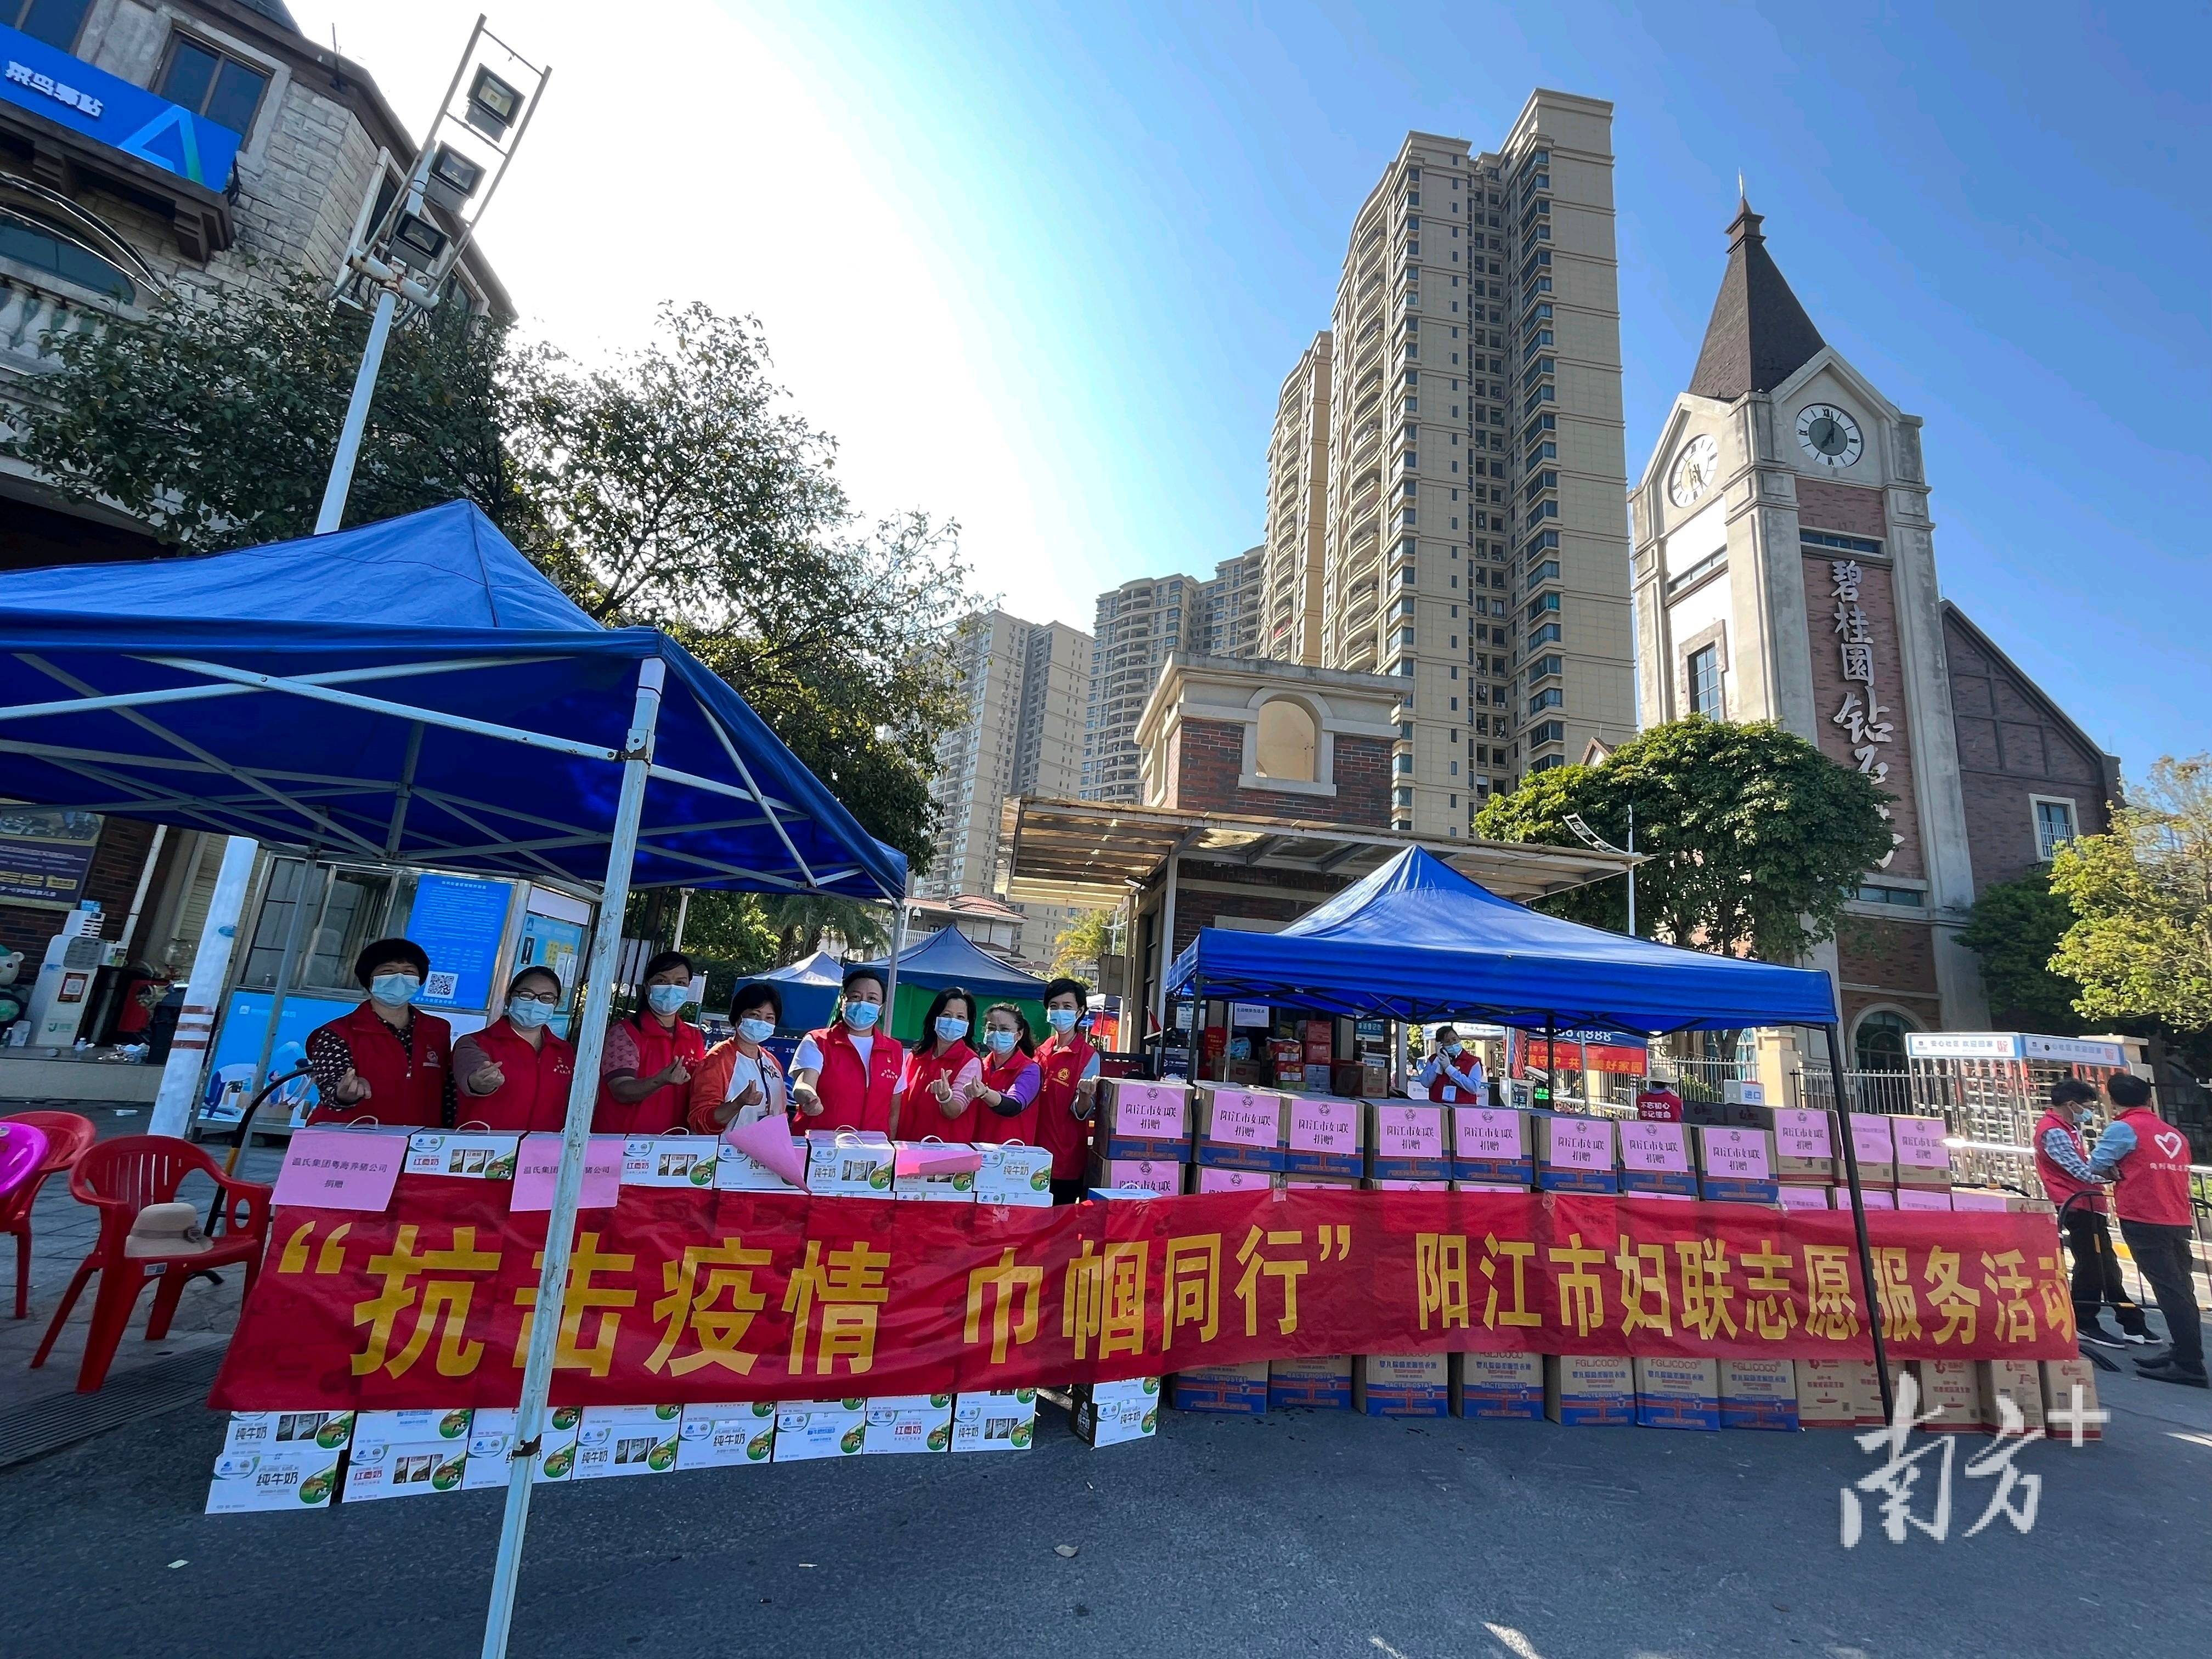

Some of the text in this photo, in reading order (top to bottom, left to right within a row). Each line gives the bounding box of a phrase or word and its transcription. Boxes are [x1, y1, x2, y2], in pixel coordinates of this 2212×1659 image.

[1745, 1090, 1761, 1100] 进口
[1125, 1103, 1177, 1118] 阳江市妇联
[1640, 1102, 1671, 1110] 不忘初心
[1220, 1109, 1271, 1126] 阳江市妇联
[1641, 1110, 1672, 1119] 牢记使命
[1140, 1118, 1161, 1130] 捐赠
[1298, 1119, 1349, 1134] 阳江市妇联
[1234, 1125, 1255, 1138] 捐赠
[1386, 1125, 1435, 1137] 阳江市妇联
[1464, 1127, 1513, 1139] 阳江市妇联
[1782, 1127, 1825, 1138] 阳江市妇联
[1313, 1133, 1334, 1146] 捐赠
[1402, 1139, 1420, 1150] 捐赠
[1558, 1136, 1605, 1150] 阳江市妇联
[1629, 1139, 1679, 1152] 阳江市妇联
[1480, 1141, 1499, 1152] 捐赠
[1572, 1151, 1591, 1162] 捐赠
[1646, 1153, 1665, 1164] 捐赠
[1713, 1147, 1760, 1159] 阳江市妇联
[523, 1166, 610, 1175] 温氏集团猪公司
[1003, 1166, 1029, 1176] 纯牛奶
[1729, 1160, 1747, 1171] 捐赠
[324, 1180, 344, 1189] 捐赠
[963, 1224, 1351, 1365] 巾帼同行”
[1416, 1232, 2073, 1345] 阳江市妇联志愿服务活动
[1286, 1372, 1335, 1380] BACTERIOSTAT
[235, 1426, 268, 1441] 纯牛奶
[958, 1426, 979, 1438] 纯牛奶
[713, 1433, 746, 1447] 纯牛奶
[581, 1450, 608, 1464] 纯牛奶
[256, 1471, 298, 1487] 纯牛奶
